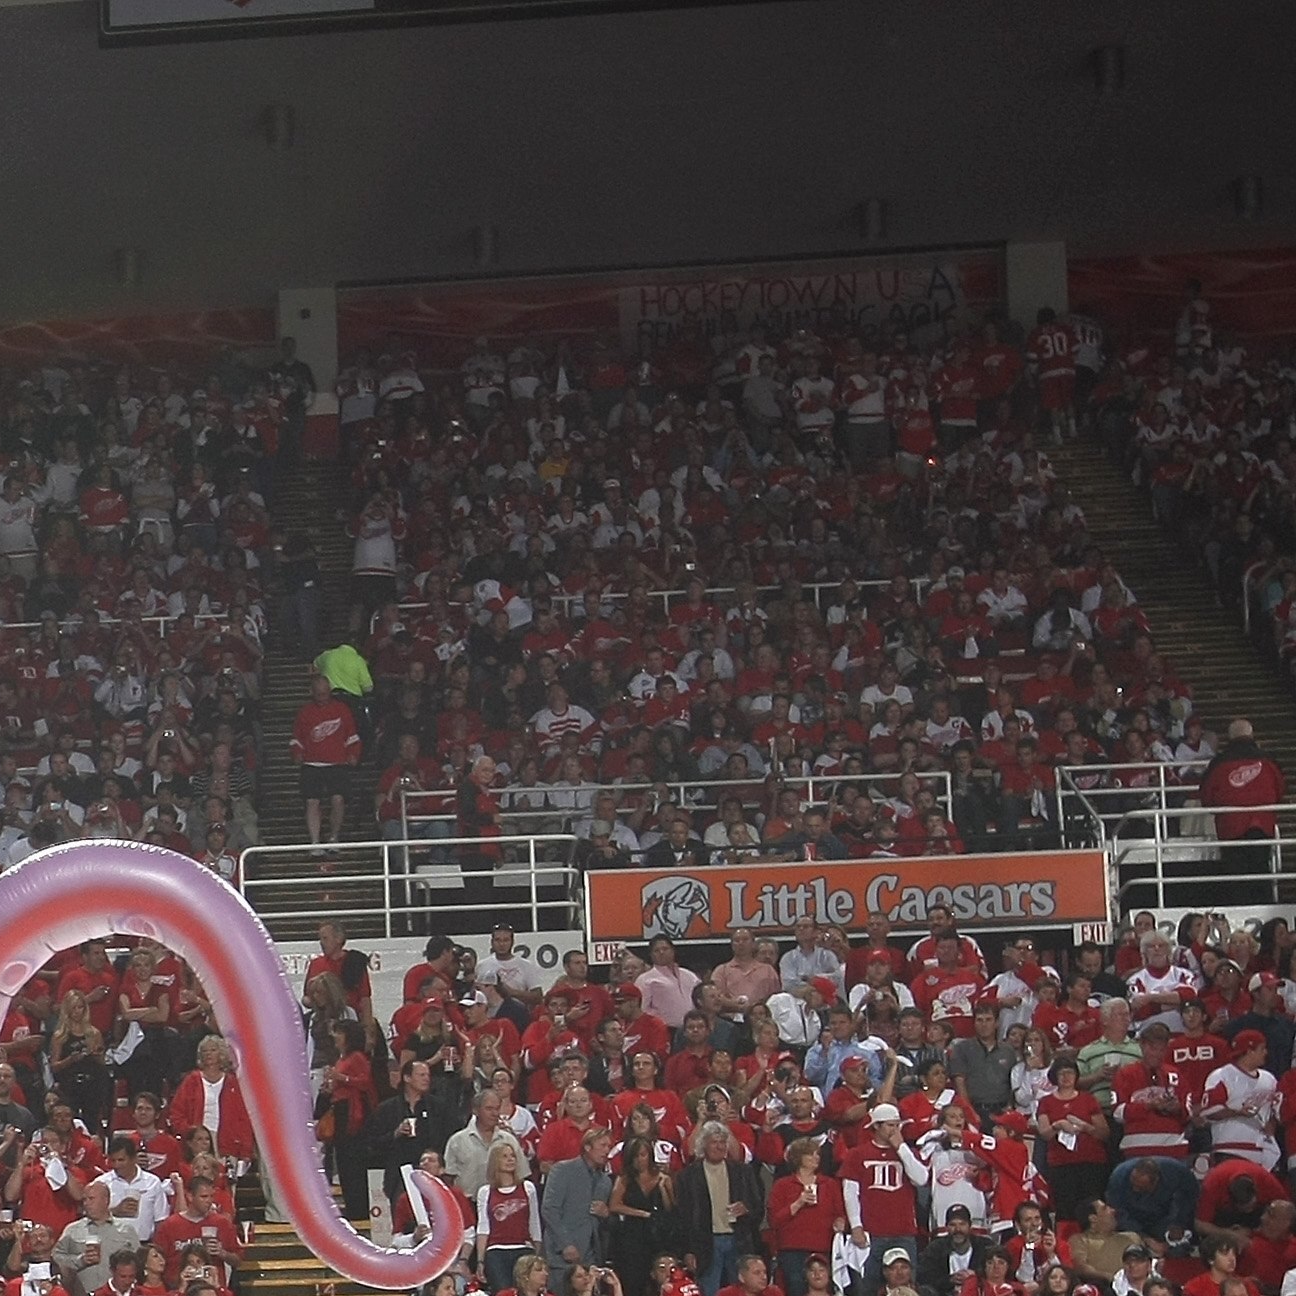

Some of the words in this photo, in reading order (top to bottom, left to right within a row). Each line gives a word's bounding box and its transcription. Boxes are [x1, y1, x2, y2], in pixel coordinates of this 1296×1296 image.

[640, 272, 857, 316] HOCKEYTOWN
[724, 877, 855, 928] Little
[866, 874, 1058, 923] Caesars
[1080, 924, 1106, 943] EXIT
